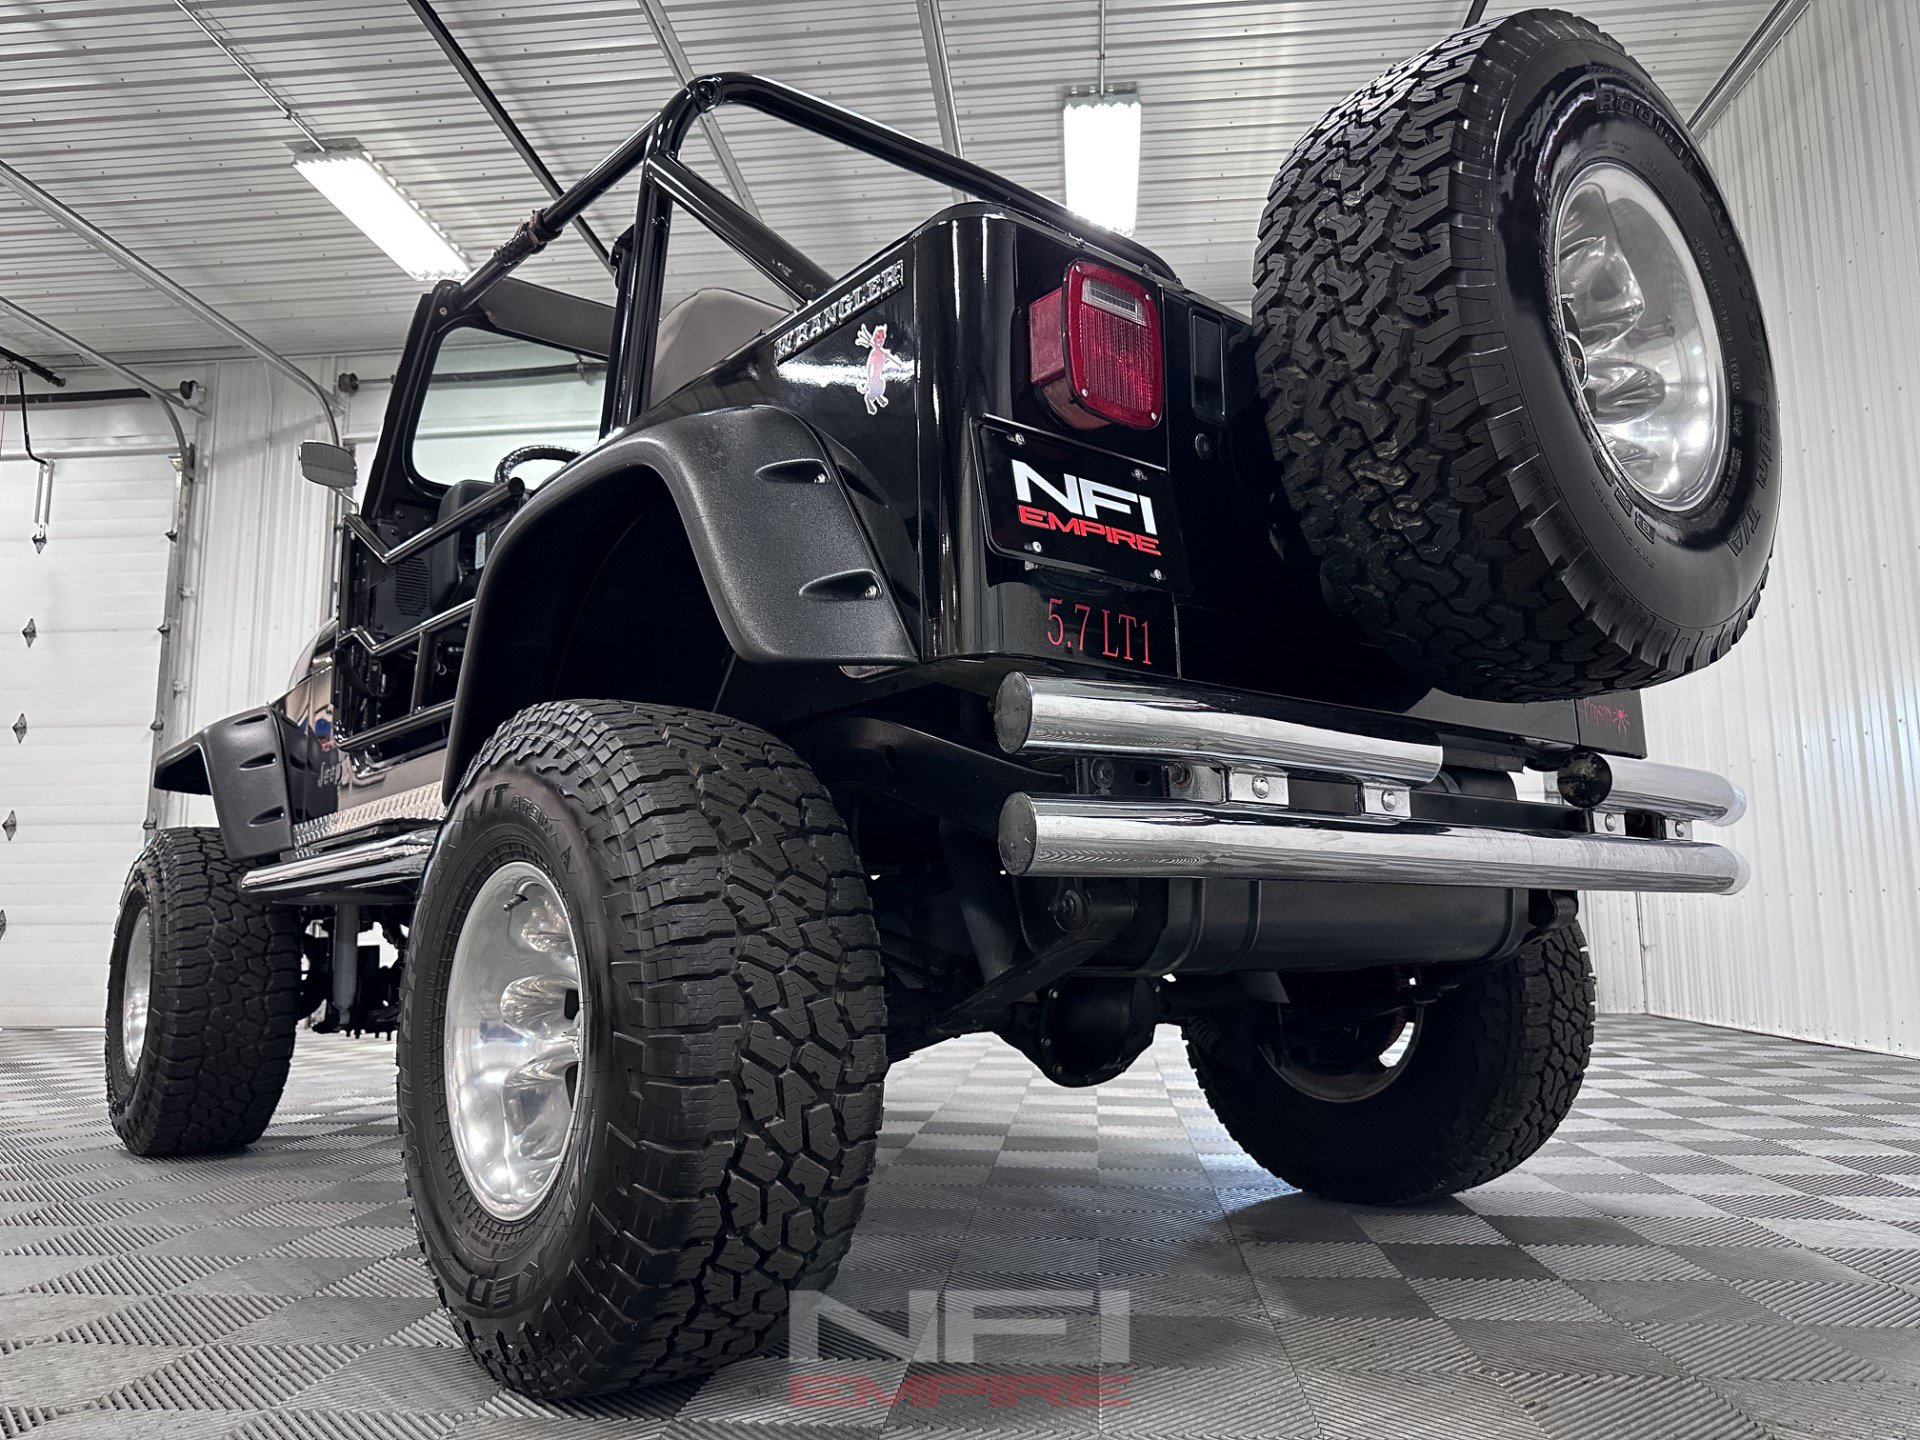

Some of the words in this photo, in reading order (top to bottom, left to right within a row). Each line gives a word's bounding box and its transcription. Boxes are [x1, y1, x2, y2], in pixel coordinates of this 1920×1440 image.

[774, 259, 904, 366] WRANGLER
[1018, 505, 1162, 556] EMPIRE
[1726, 506, 1762, 557] T/A
[1047, 598, 1091, 651] 5.7
[1101, 609, 1152, 665] LT1
[317, 762, 342, 788] Jeep
